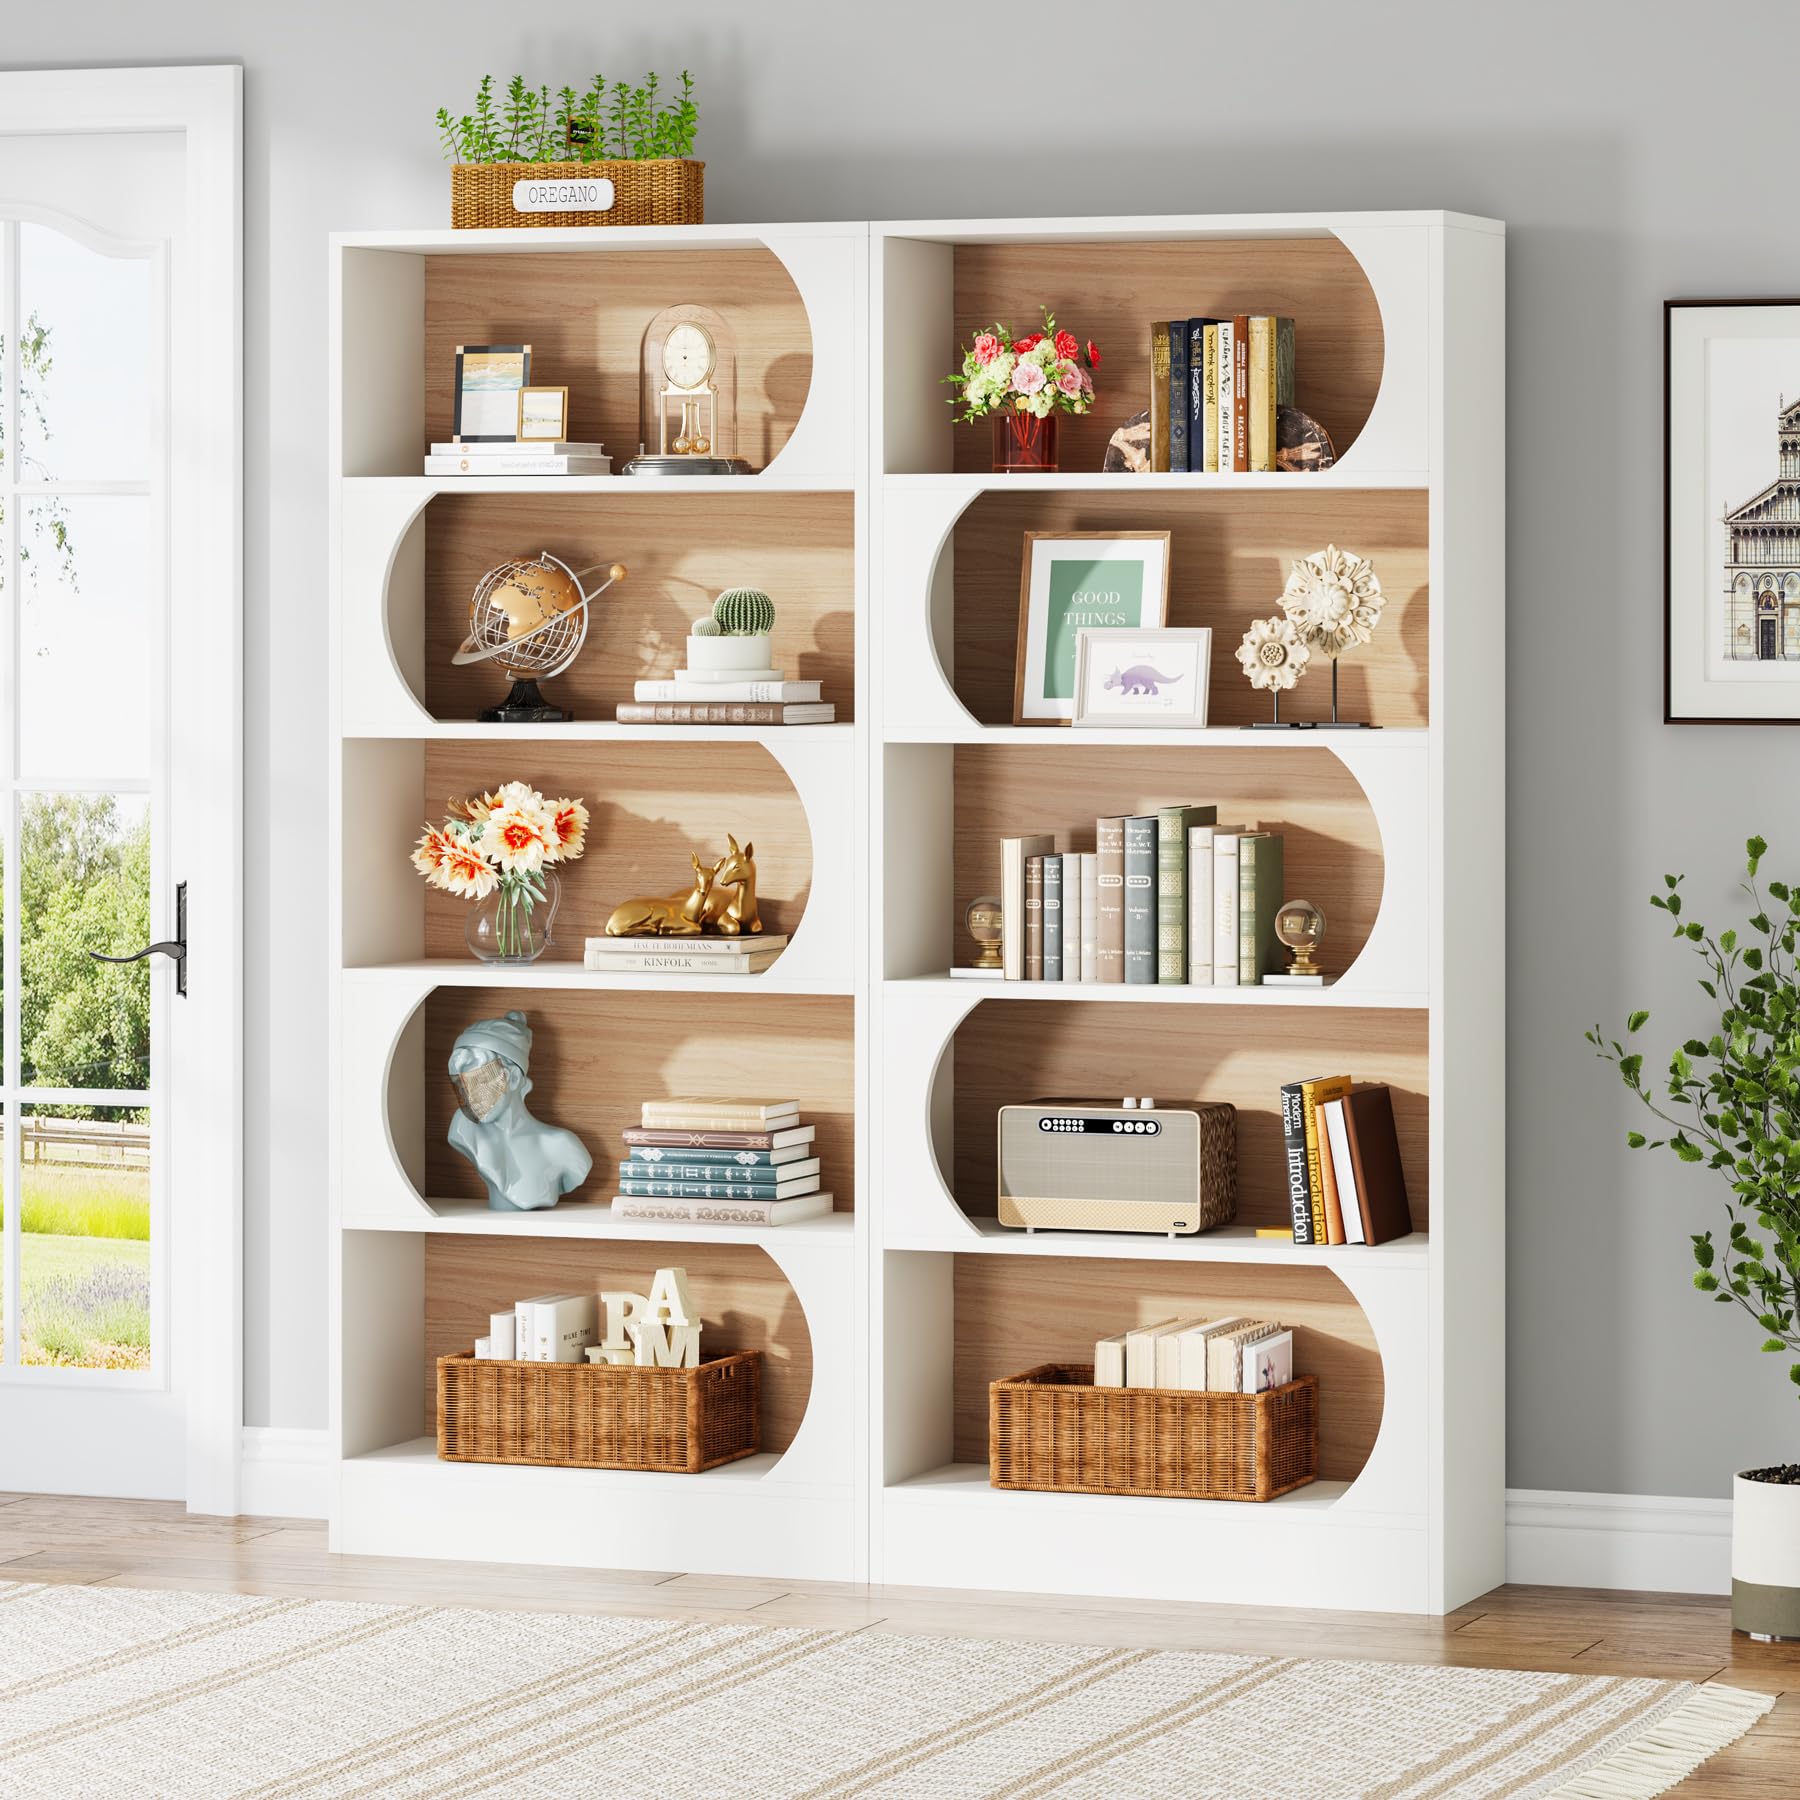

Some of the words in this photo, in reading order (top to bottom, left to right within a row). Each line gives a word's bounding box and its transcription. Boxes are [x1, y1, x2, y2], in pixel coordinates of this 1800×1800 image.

[528, 186, 598, 204] OREGANO
[1071, 591, 1121, 604] GOOD
[1063, 612, 1126, 625] THINGS
[644, 957, 692, 968] KINFOLK
[1281, 1089, 1293, 1136] American
[1291, 1093, 1303, 1129] Modern
[1308, 1091, 1317, 1127] Modern
[1288, 1148, 1310, 1243] Introduction
[1308, 1148, 1324, 1242] Introduction
